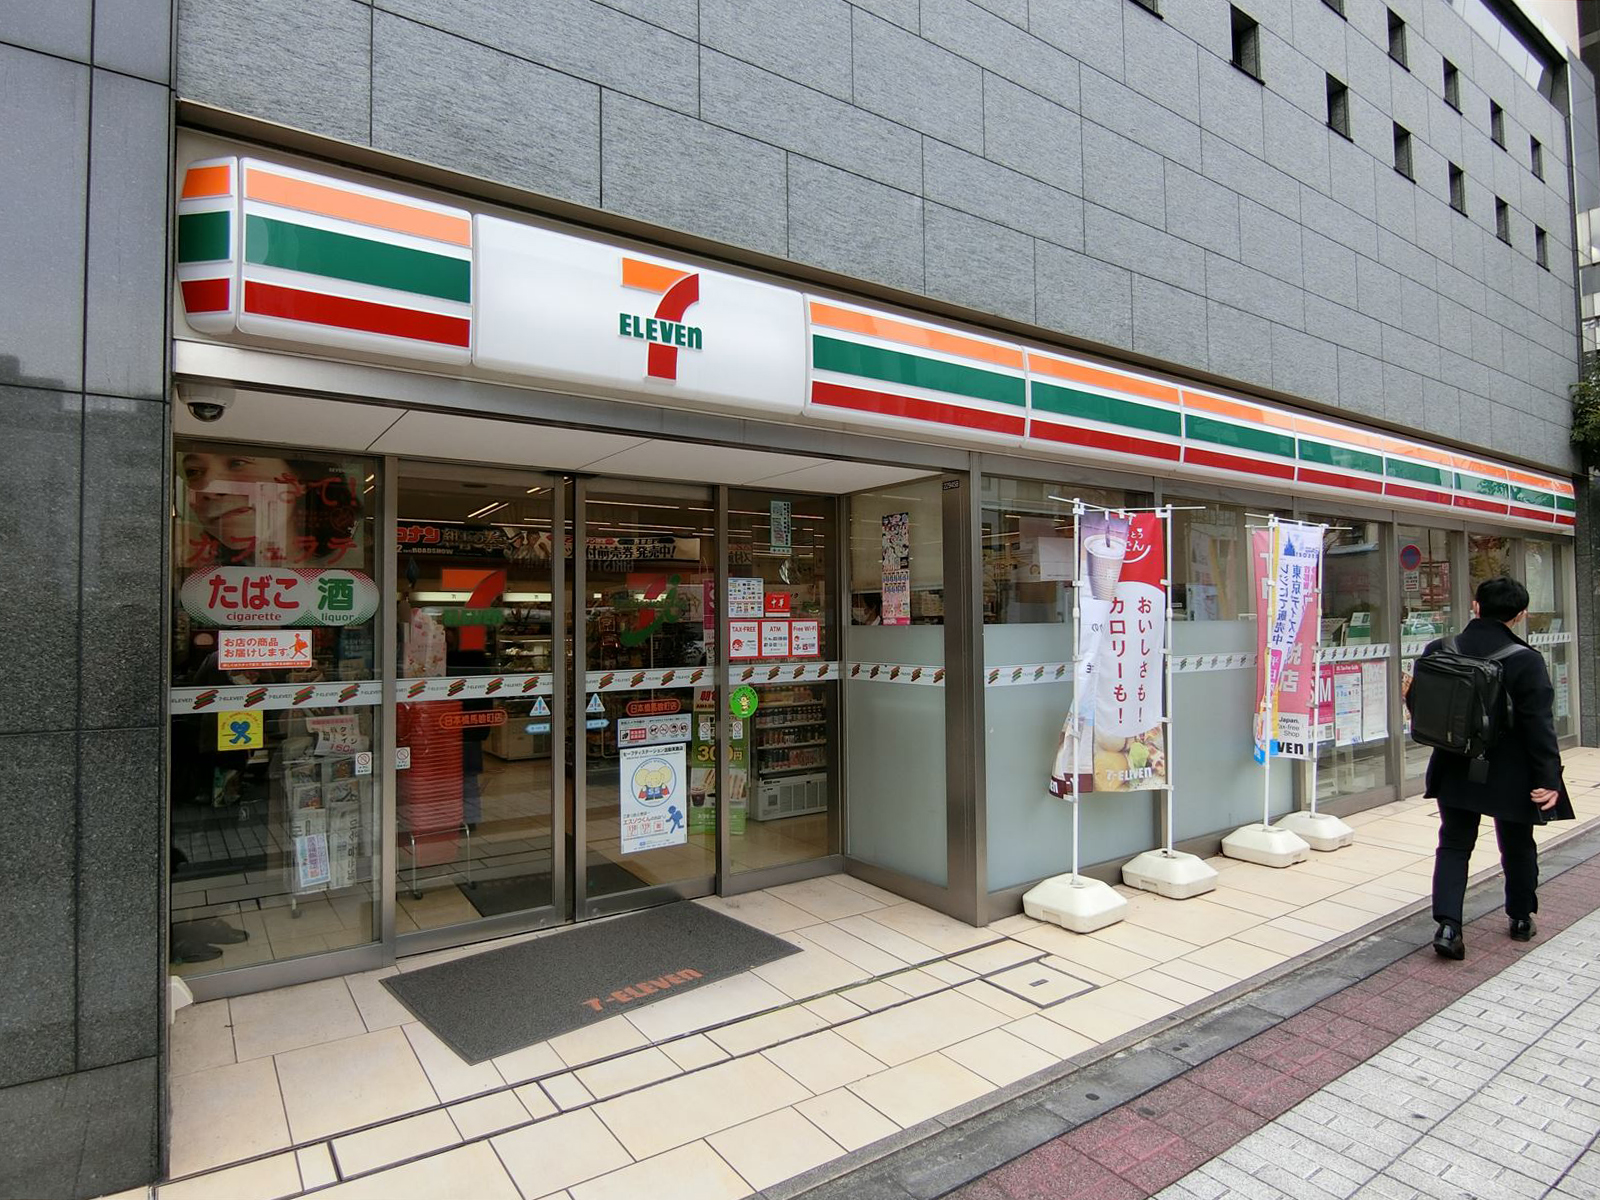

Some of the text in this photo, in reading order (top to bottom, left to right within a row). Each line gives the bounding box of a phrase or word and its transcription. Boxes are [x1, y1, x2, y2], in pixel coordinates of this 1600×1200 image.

[208, 574, 354, 611] たばこ 酒
[226, 612, 354, 623] cigarette liquor
[223, 637, 279, 647] お店の商品
